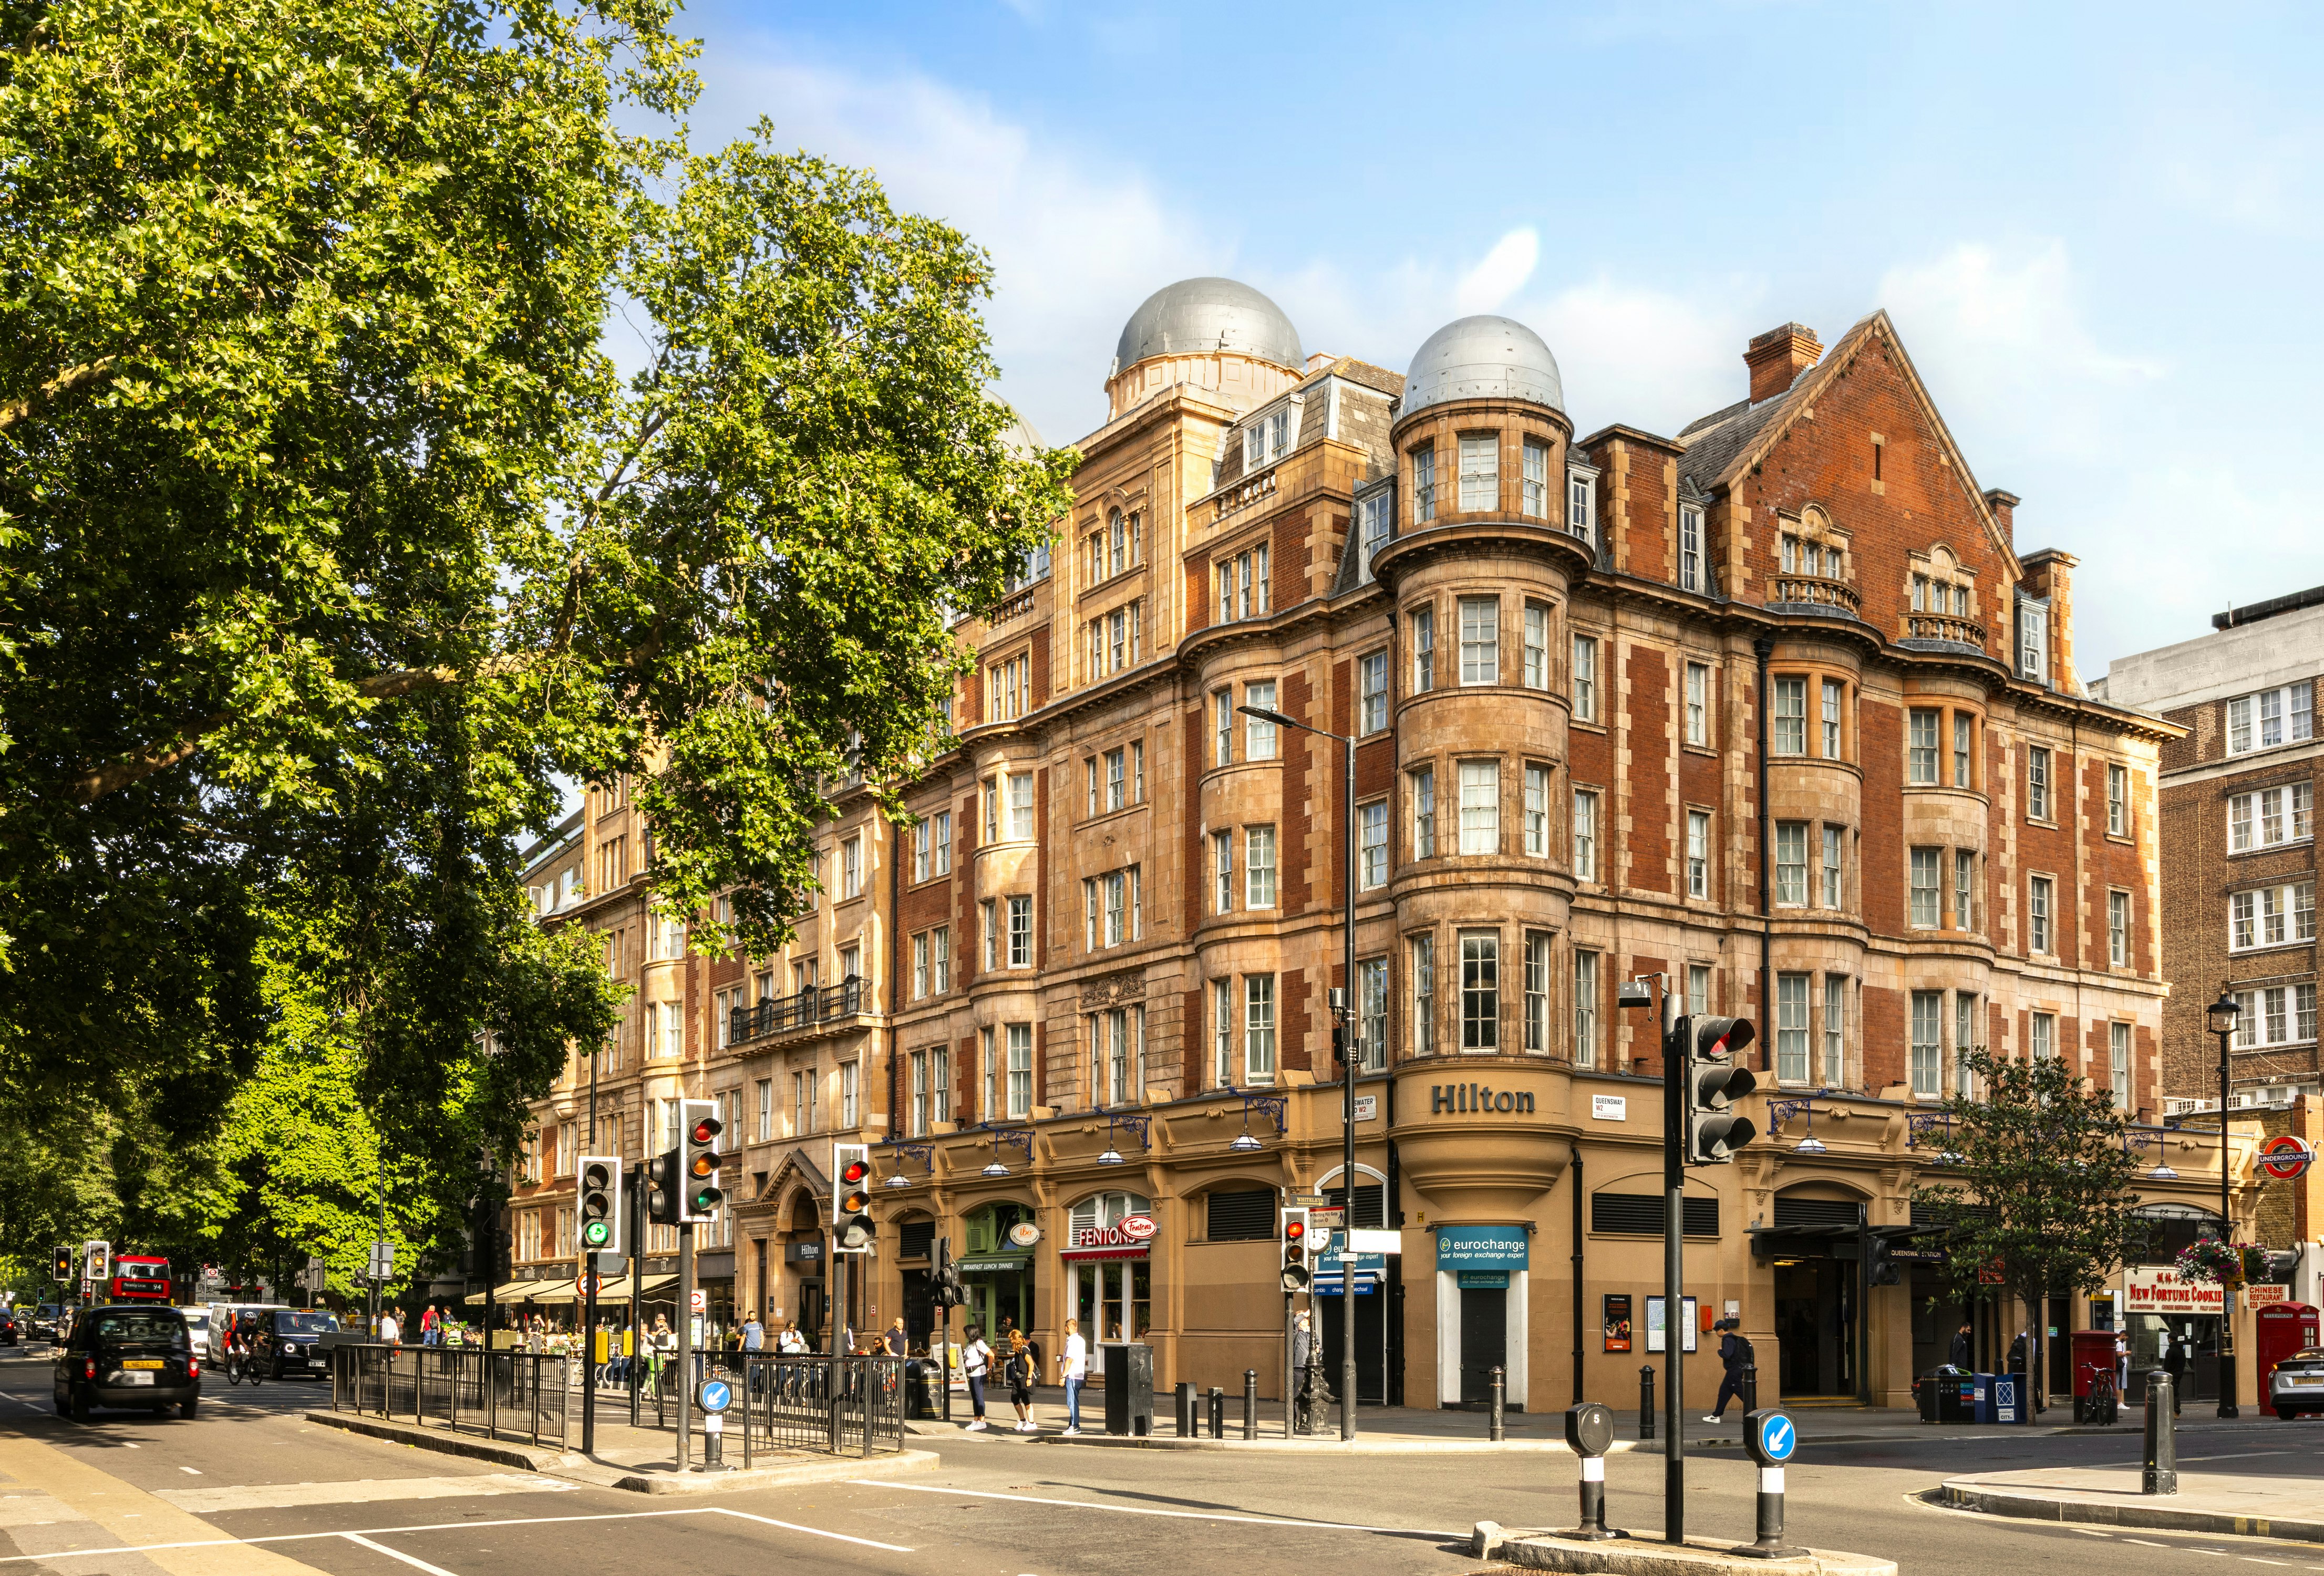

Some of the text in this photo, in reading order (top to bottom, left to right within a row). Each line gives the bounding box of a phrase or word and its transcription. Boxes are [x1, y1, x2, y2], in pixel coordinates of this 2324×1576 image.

[1431, 1083, 1535, 1112] Hilton
[1128, 1220, 1151, 1232] Fentons
[801, 1245, 818, 1254] Hilton
[1454, 1239, 1525, 1252] eurochange
[2130, 1284, 2150, 1300] NEW
[2151, 1284, 2190, 1301] FORTUNE
[2192, 1286, 2223, 1302] COOKIE
[1594, 1414, 1600, 1424] 5
